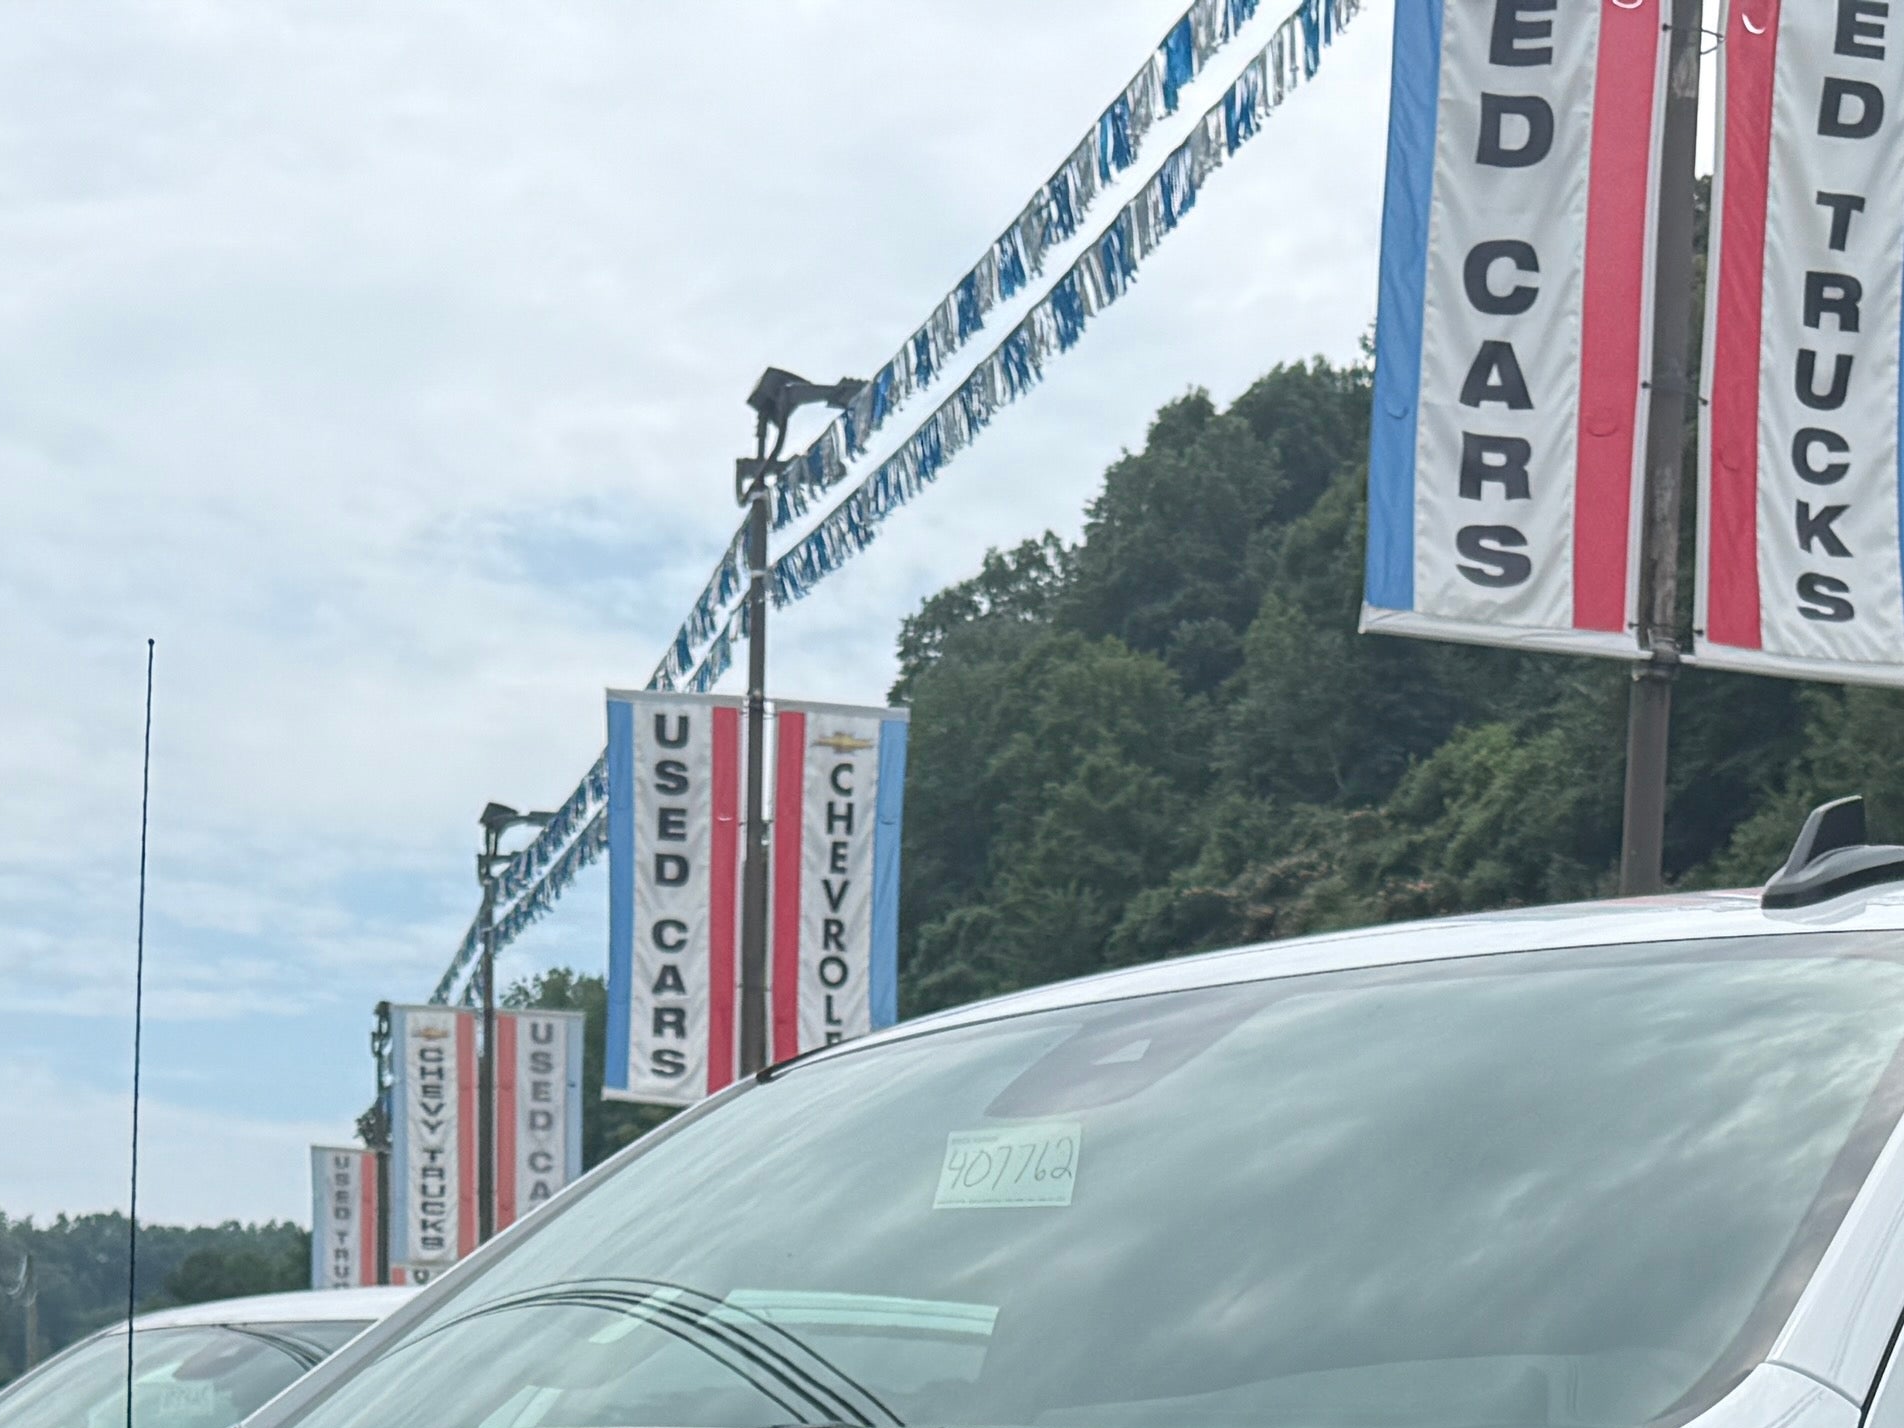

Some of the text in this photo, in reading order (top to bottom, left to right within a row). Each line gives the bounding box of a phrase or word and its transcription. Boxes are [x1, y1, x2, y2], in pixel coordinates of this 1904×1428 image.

[1455, 238, 1540, 589] CARS
[1791, 190, 1866, 623] TRUCKS
[650, 713, 690, 1079] USED CARS
[419, 1048, 446, 1135] CHEVY
[527, 1022, 554, 1209] USED CA
[946, 1135, 1074, 1191] 407762
[420, 1149, 446, 1251] TRUCKS
